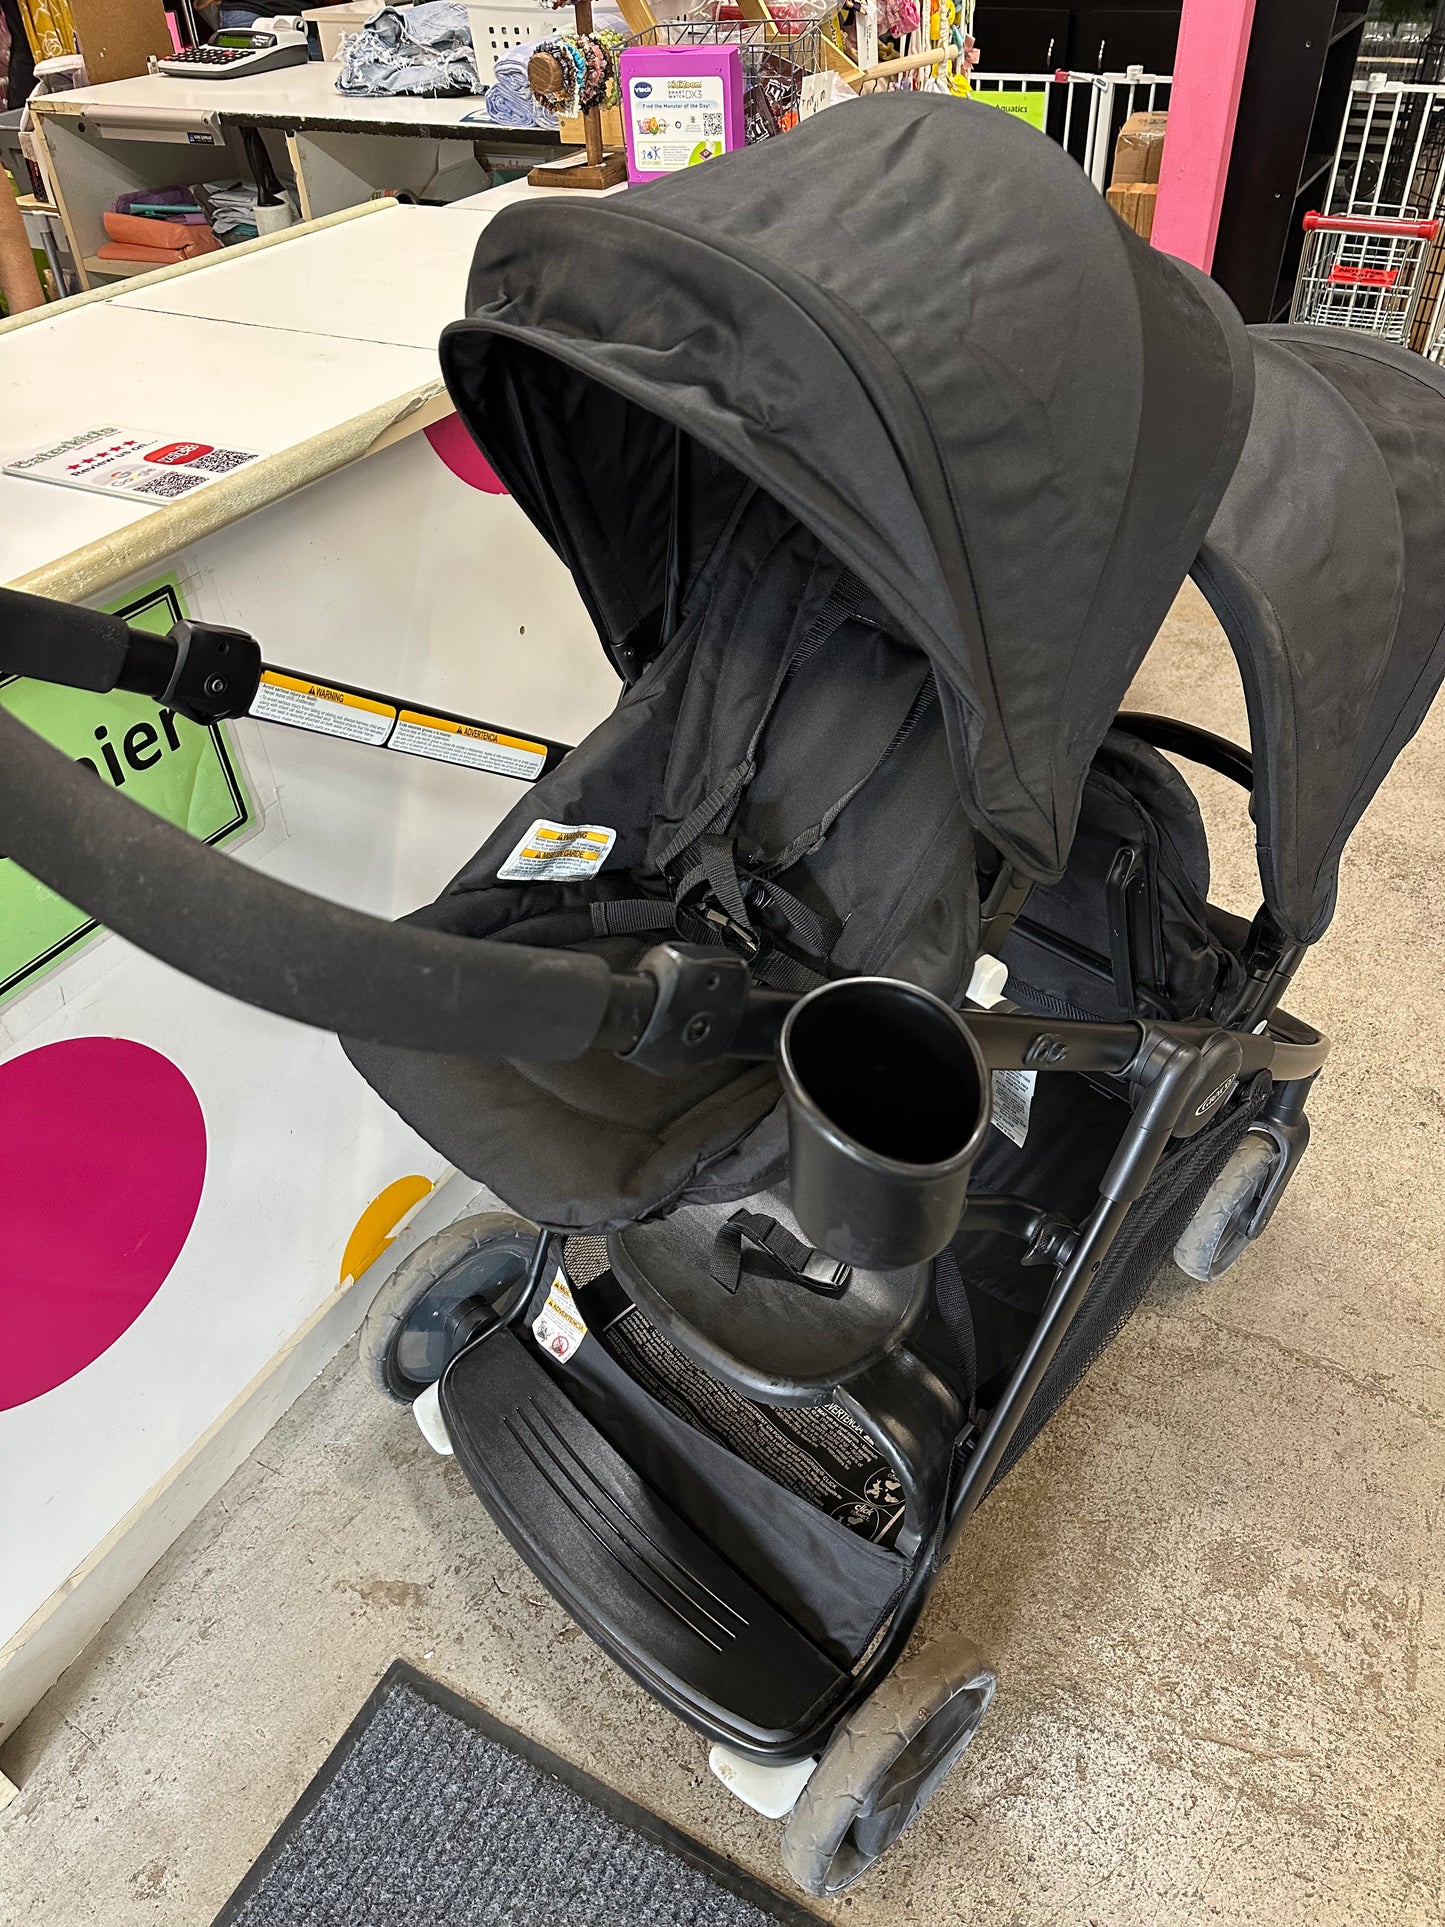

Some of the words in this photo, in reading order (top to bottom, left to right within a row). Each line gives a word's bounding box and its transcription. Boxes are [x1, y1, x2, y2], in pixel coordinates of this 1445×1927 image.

[71, 458, 115, 477] Review
[116, 449, 131, 458] us
[316, 687, 344, 703] WARNING
[463, 727, 498, 742] ADVERTENCIA
[552, 1304, 583, 1331] ADVERTENCIA
[822, 1475, 837, 1489] CLICK
[854, 1502, 874, 1515] click
